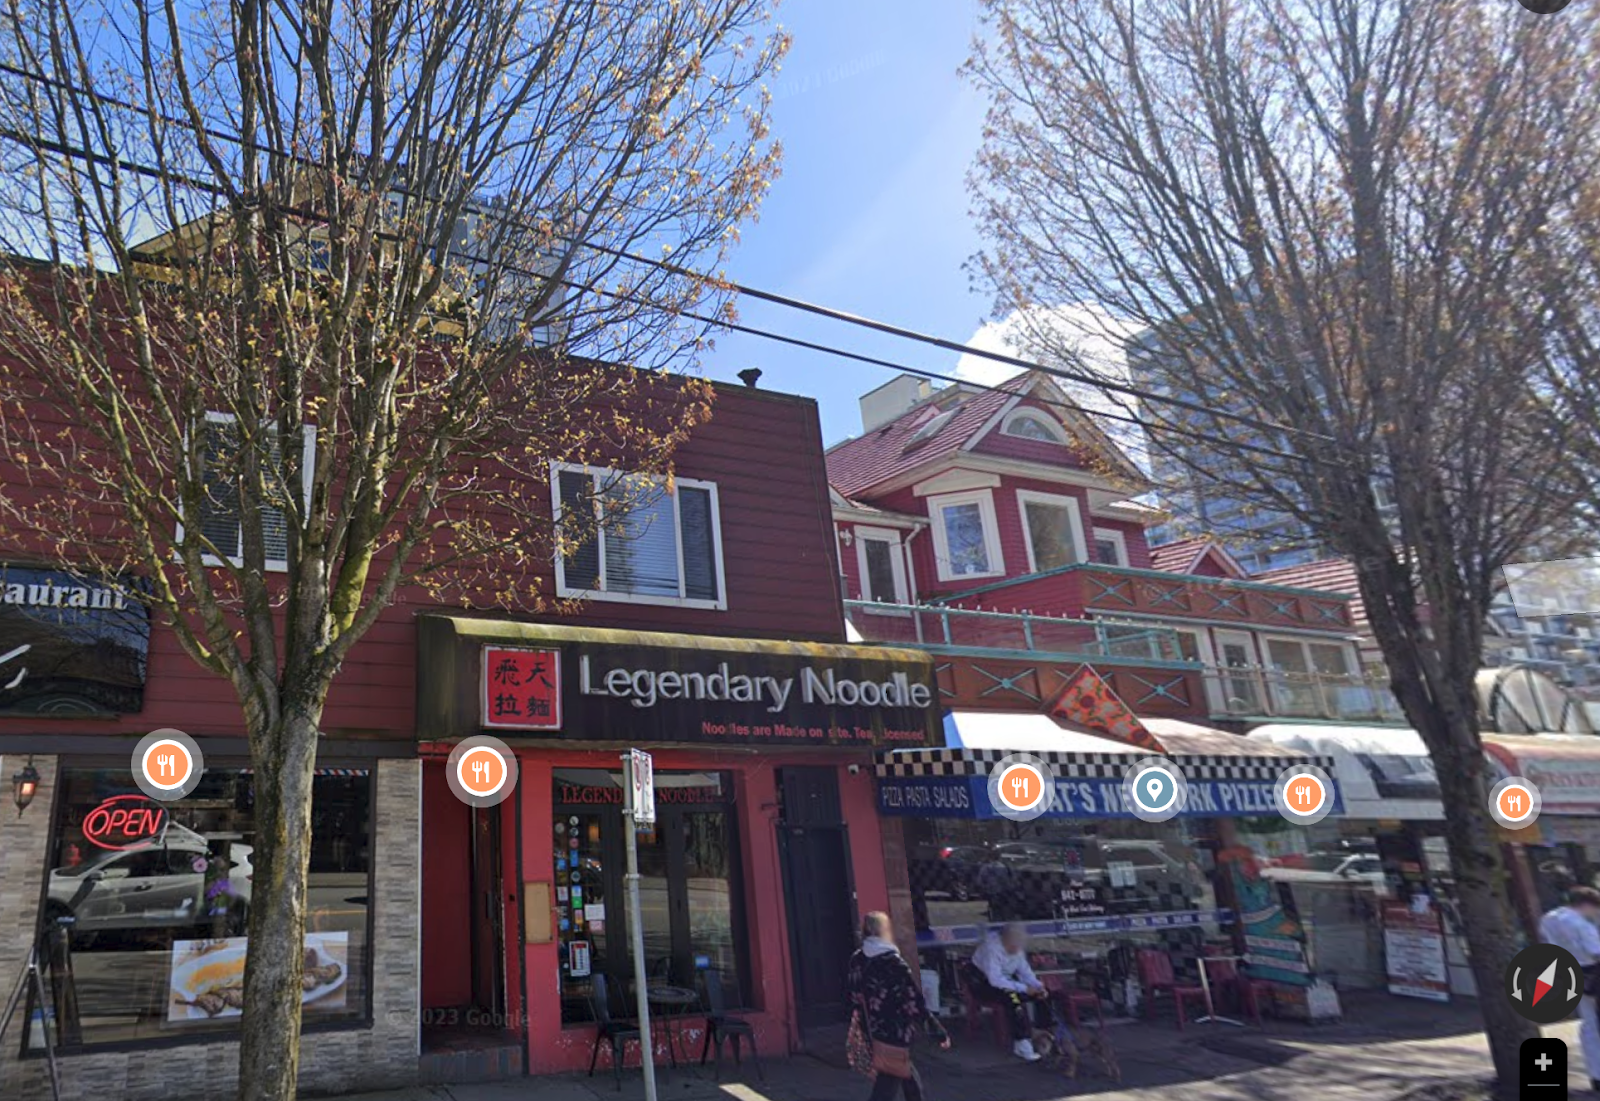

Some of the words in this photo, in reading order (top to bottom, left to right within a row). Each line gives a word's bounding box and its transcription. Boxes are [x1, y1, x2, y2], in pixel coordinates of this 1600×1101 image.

[579, 654, 793, 713] Legendary
[800, 662, 931, 709] Noodle
[752, 725, 771, 737] are
[808, 727, 824, 739] on
[882, 786, 906, 807] PIZZA
[906, 786, 931, 808] PASTA
[932, 786, 970, 809] SALADS
[1101, 783, 1141, 813] NE
[87, 808, 163, 836] OPEN
